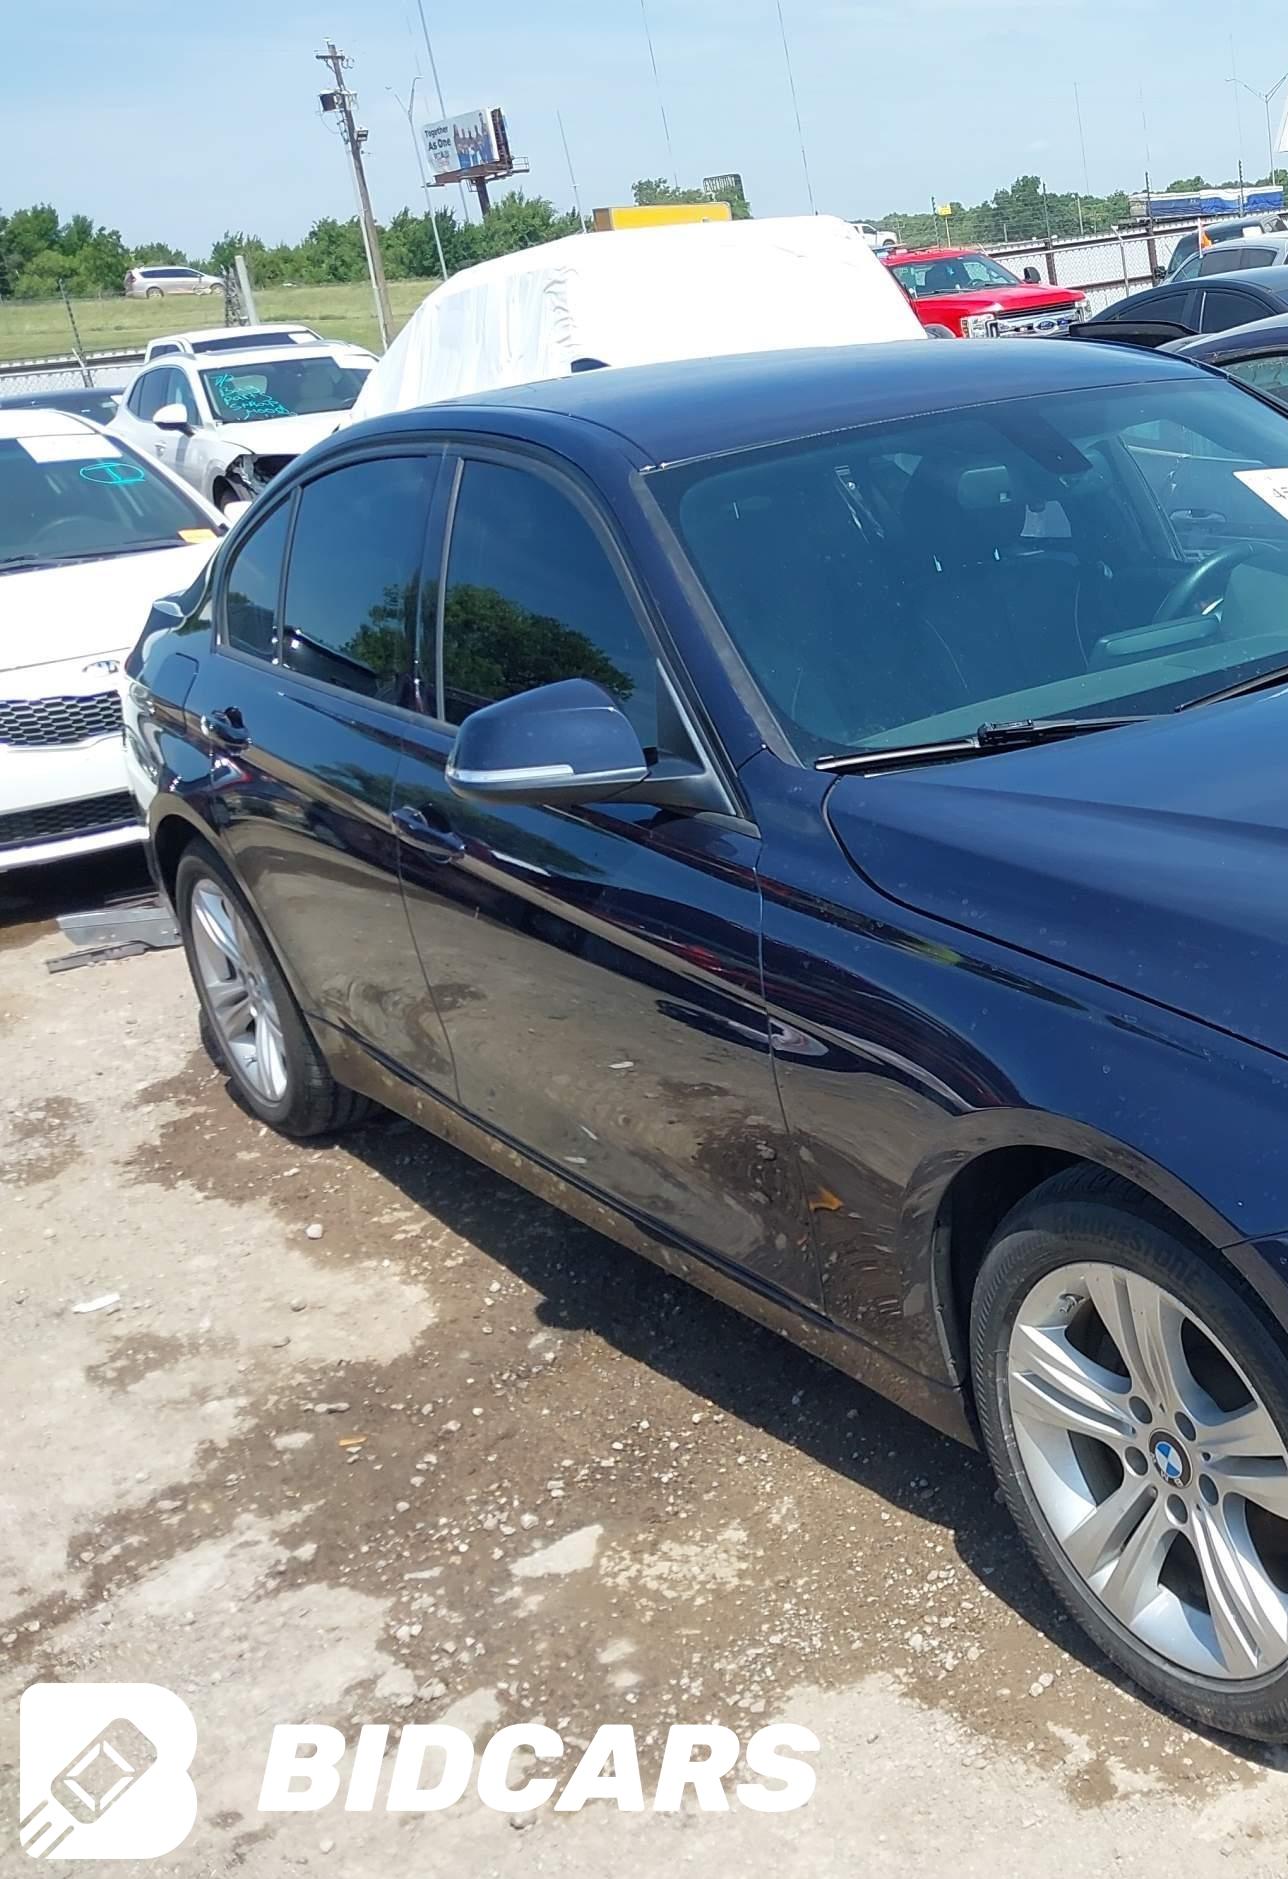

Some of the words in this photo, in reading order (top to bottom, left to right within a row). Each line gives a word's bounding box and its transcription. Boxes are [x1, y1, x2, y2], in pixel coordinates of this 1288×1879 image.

[424, 126, 448, 138] Together
[428, 141, 438, 151] As
[438, 138, 452, 149] One
